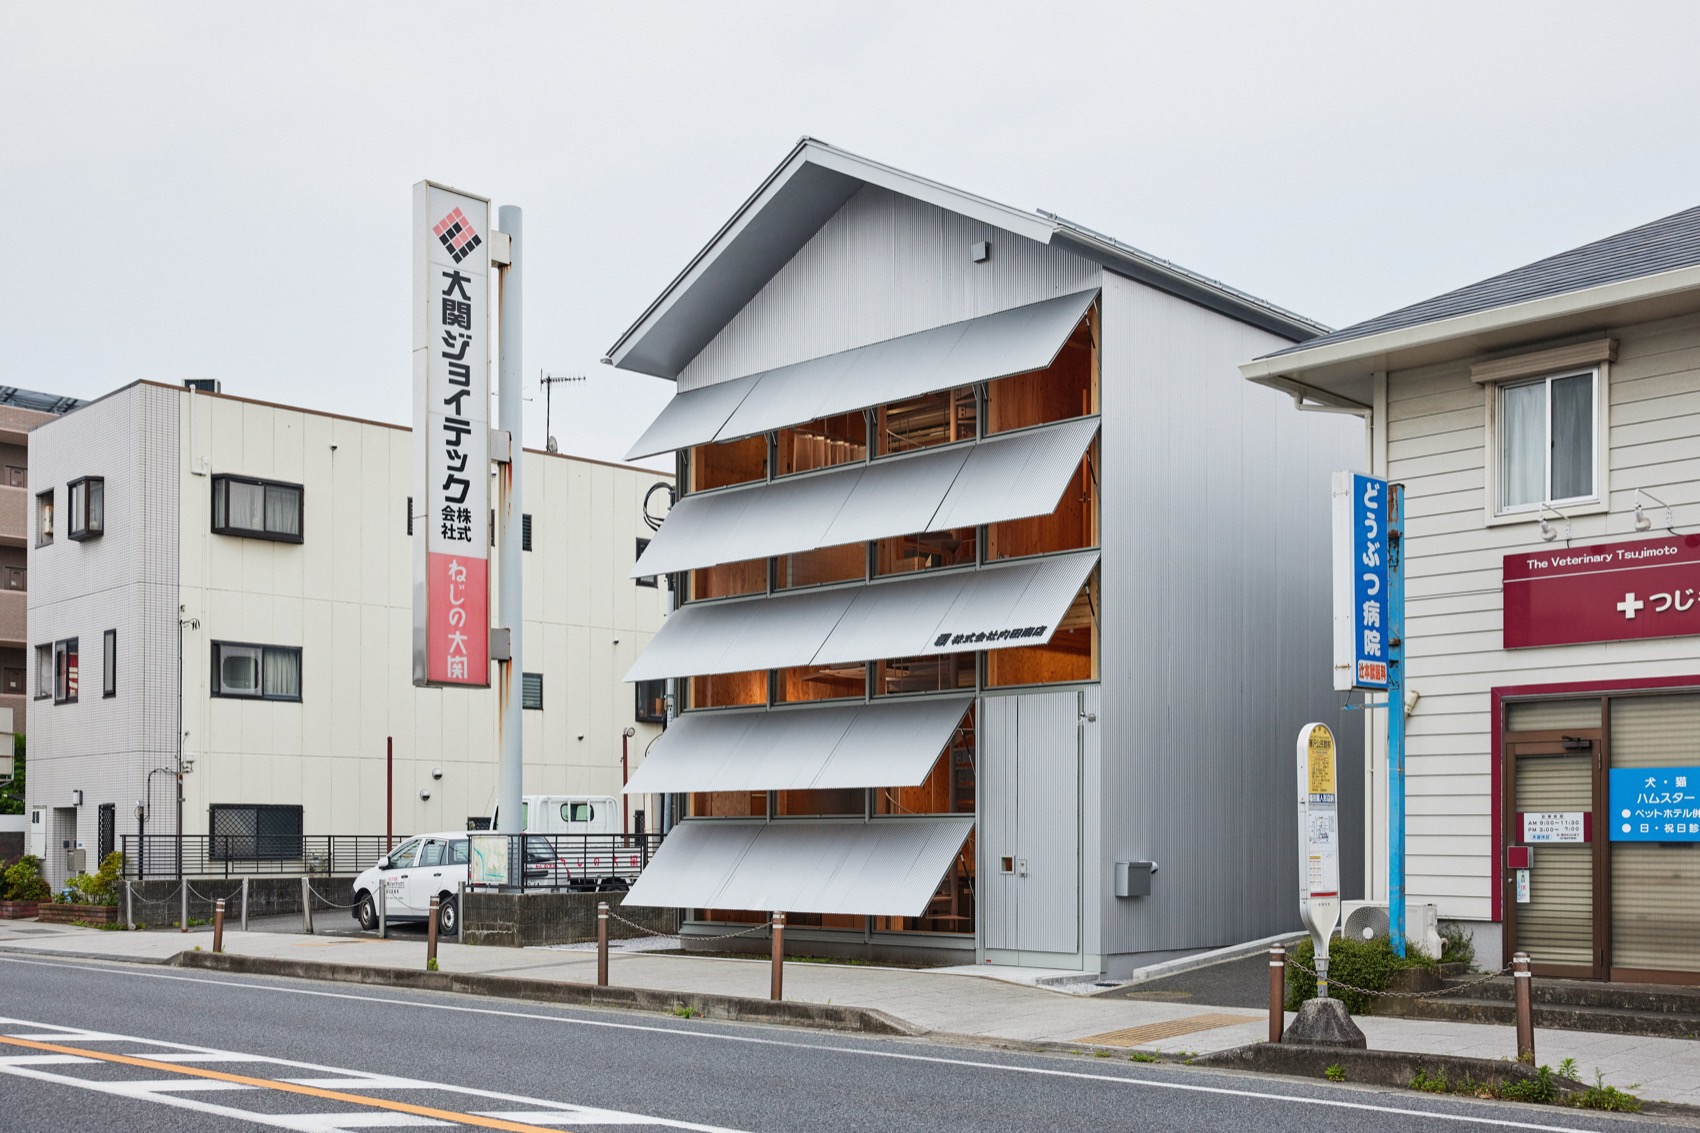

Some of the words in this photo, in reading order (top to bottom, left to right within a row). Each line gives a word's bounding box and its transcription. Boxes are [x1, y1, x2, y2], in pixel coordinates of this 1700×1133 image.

[441, 270, 472, 504] 大関ジョイテック
[1362, 481, 1382, 657] どうぶつ病院
[1526, 559, 1548, 570] The
[1551, 553, 1613, 567] Veterinary
[1616, 546, 1678, 560] Tsujimoto
[447, 559, 468, 679] ねじの大関
[1649, 588, 1700, 612] つじ
[1637, 792, 1696, 804] ハムスター
